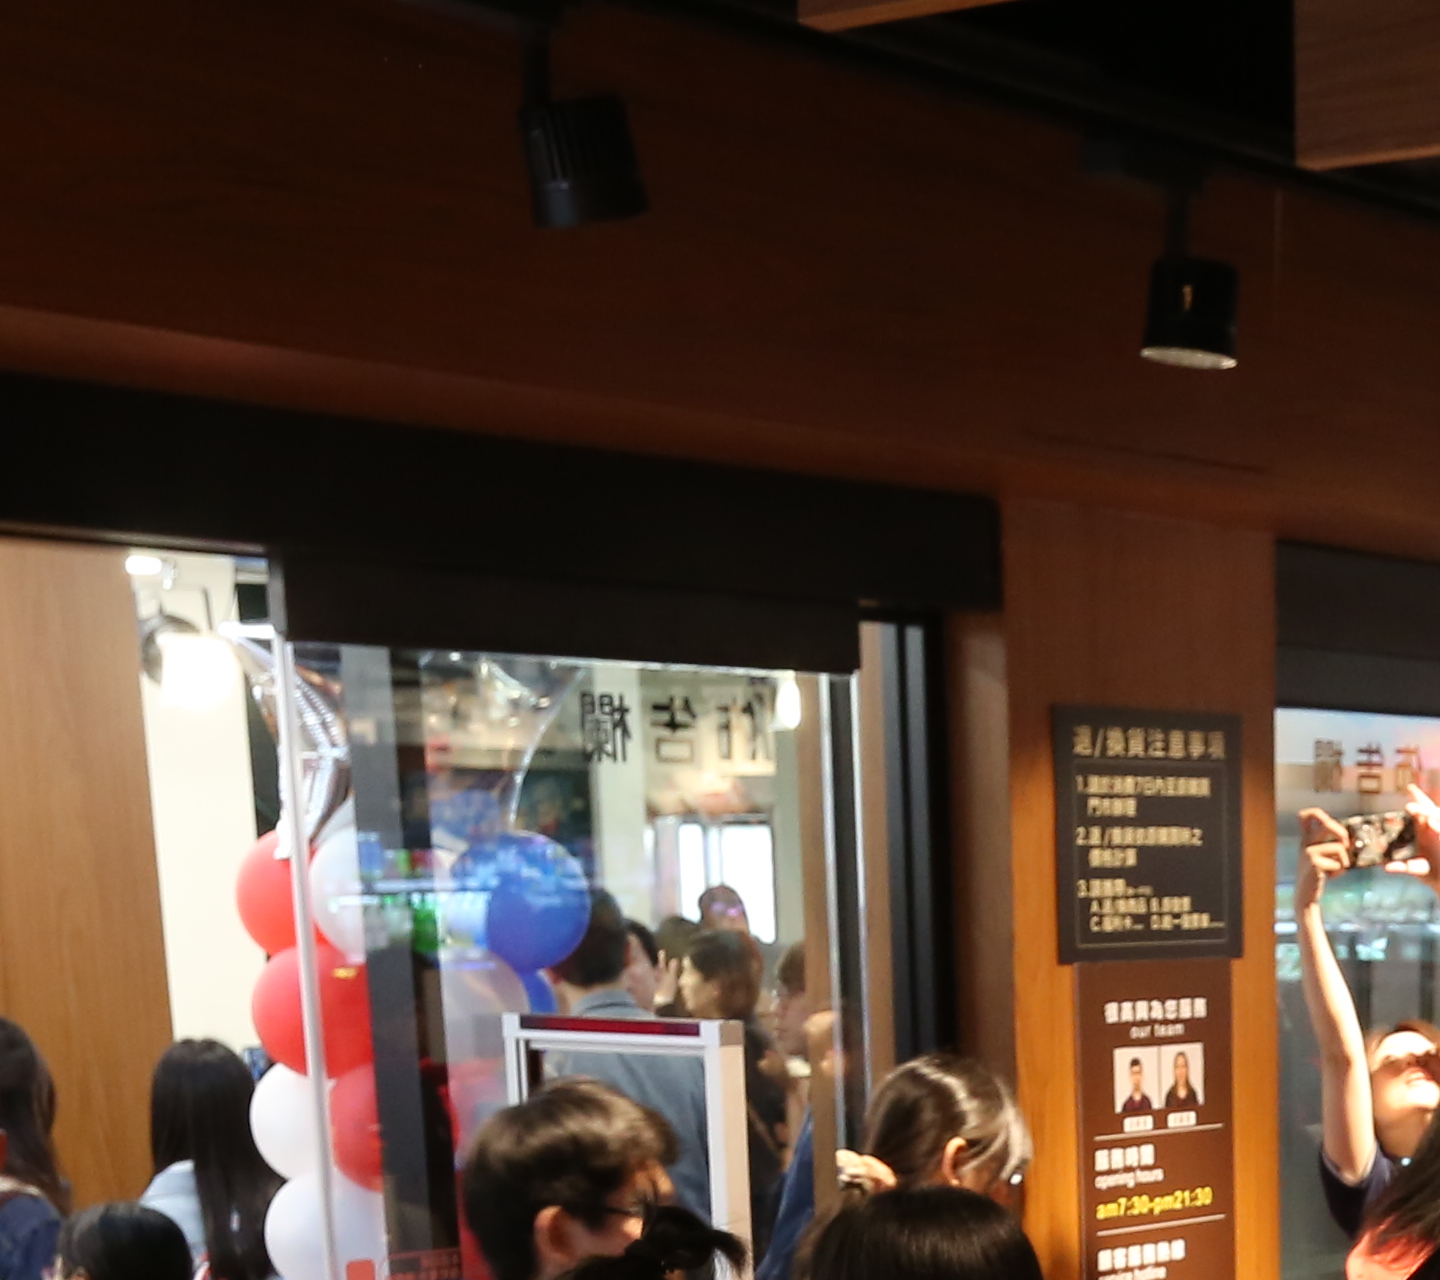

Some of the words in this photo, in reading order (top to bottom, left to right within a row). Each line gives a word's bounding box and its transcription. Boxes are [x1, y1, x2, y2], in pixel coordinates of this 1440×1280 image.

[1095, 1171, 1135, 1189] opening
[1135, 1167, 1165, 1184] hours
[1096, 1186, 1214, 1220] am7:30-pm21:30
